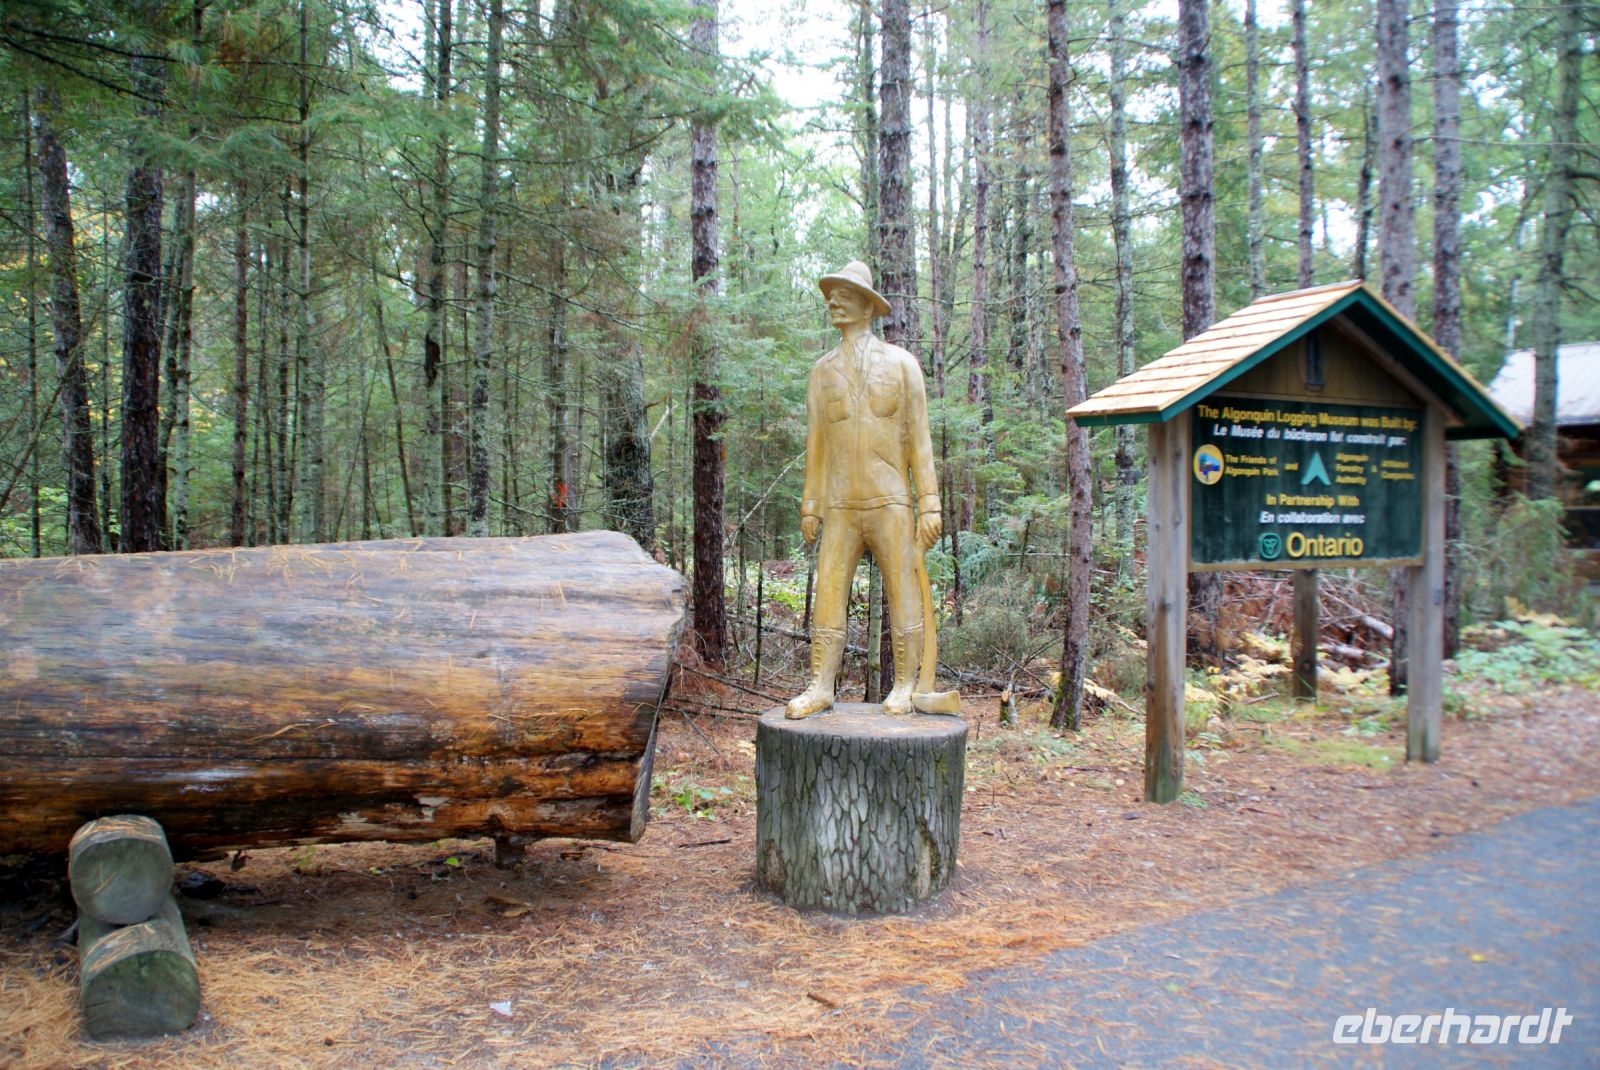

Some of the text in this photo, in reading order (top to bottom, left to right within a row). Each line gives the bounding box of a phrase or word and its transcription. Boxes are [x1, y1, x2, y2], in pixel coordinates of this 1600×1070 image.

[1198, 405, 1219, 418] The
[1222, 407, 1274, 424] Algonquin
[1277, 410, 1317, 427] Logging
[1318, 412, 1359, 426] Museum
[1361, 417, 1379, 427] was
[1381, 416, 1402, 428] Built
[1213, 424, 1228, 436] Le
[1231, 424, 1264, 438] Musée
[1267, 427, 1280, 439] du
[1284, 428, 1327, 442] bûcheron
[1346, 433, 1386, 444] construit
[1226, 455, 1238, 463] The
[1240, 456, 1266, 464] Friends
[1225, 466, 1260, 477] Algonquin
[1266, 494, 1360, 508] In Partnership With
[1259, 512, 1366, 524] En collaboration avec
[1286, 532, 1364, 558] Ontario
